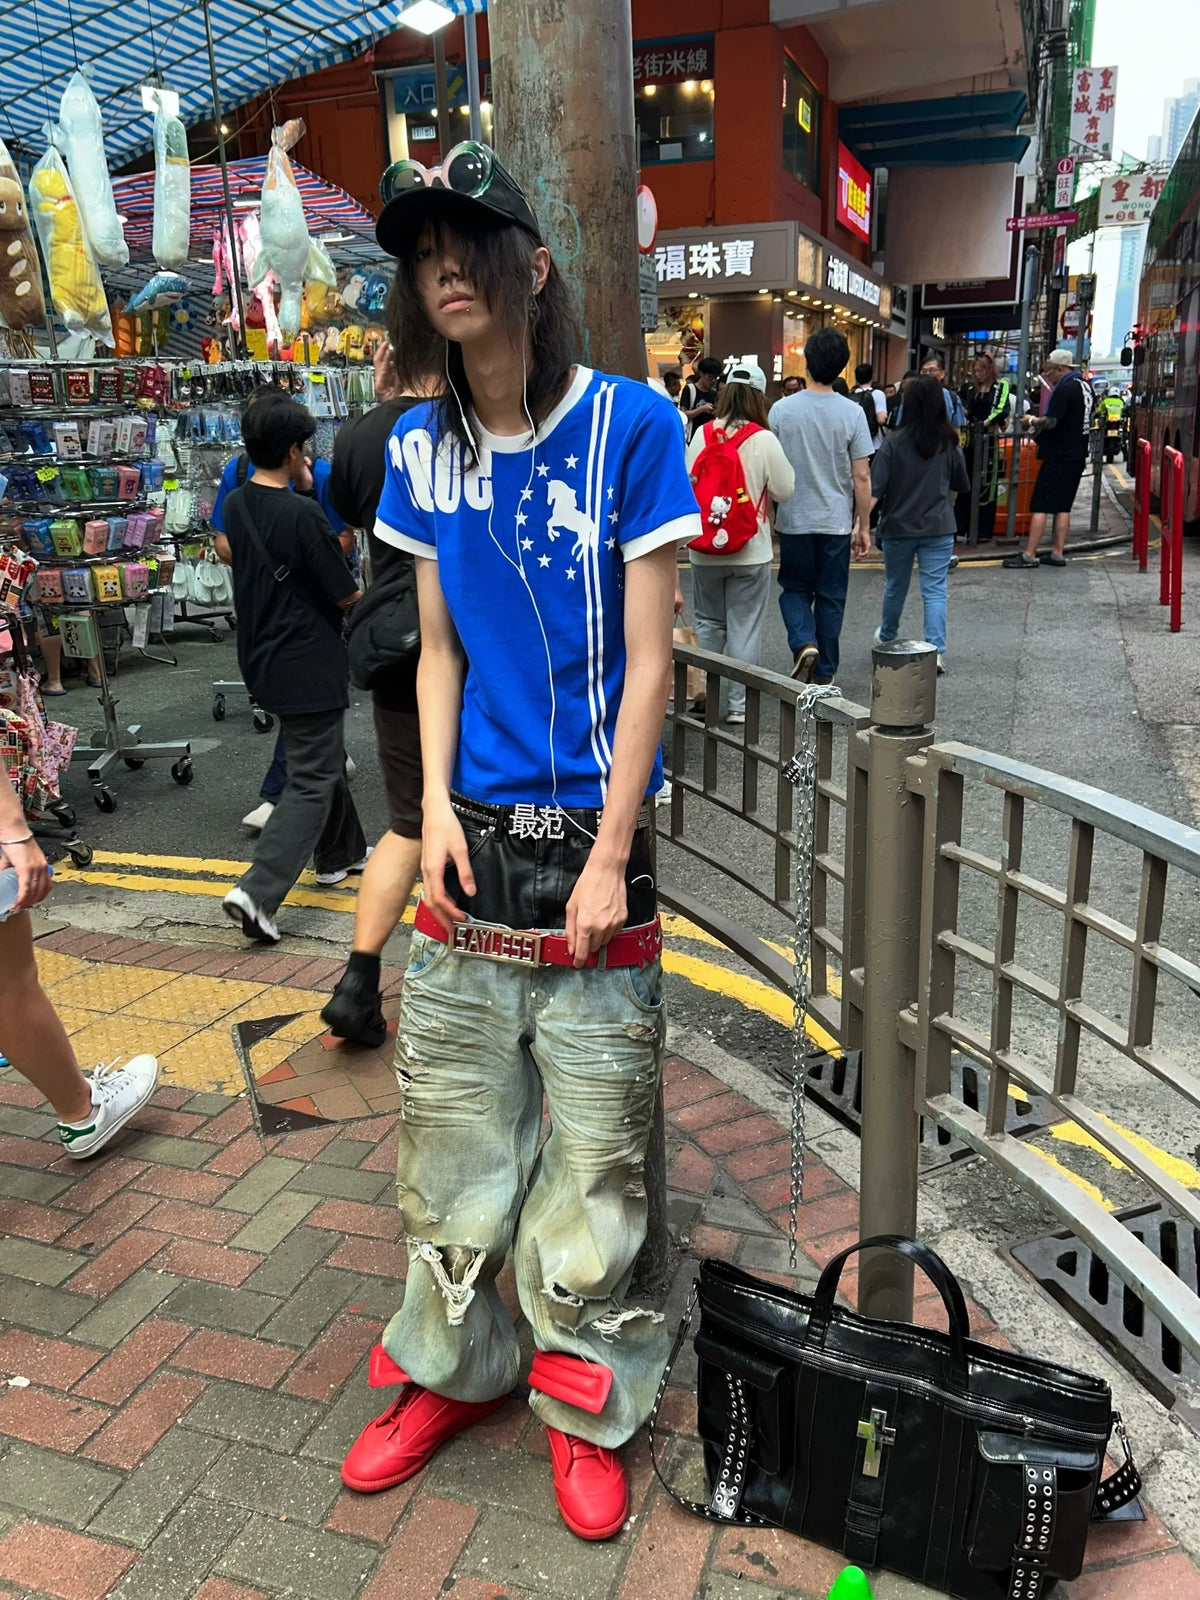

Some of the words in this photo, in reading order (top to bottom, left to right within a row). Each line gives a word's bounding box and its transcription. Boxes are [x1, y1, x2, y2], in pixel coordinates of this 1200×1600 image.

[403, 82, 437, 106] 入口
[1096, 68, 1115, 115] 皇都
[1057, 177, 1071, 205] 旺角
[1111, 177, 1166, 203] 皇都
[655, 240, 755, 282] 福珠寶
[455, 927, 533, 961] SAYLESS
